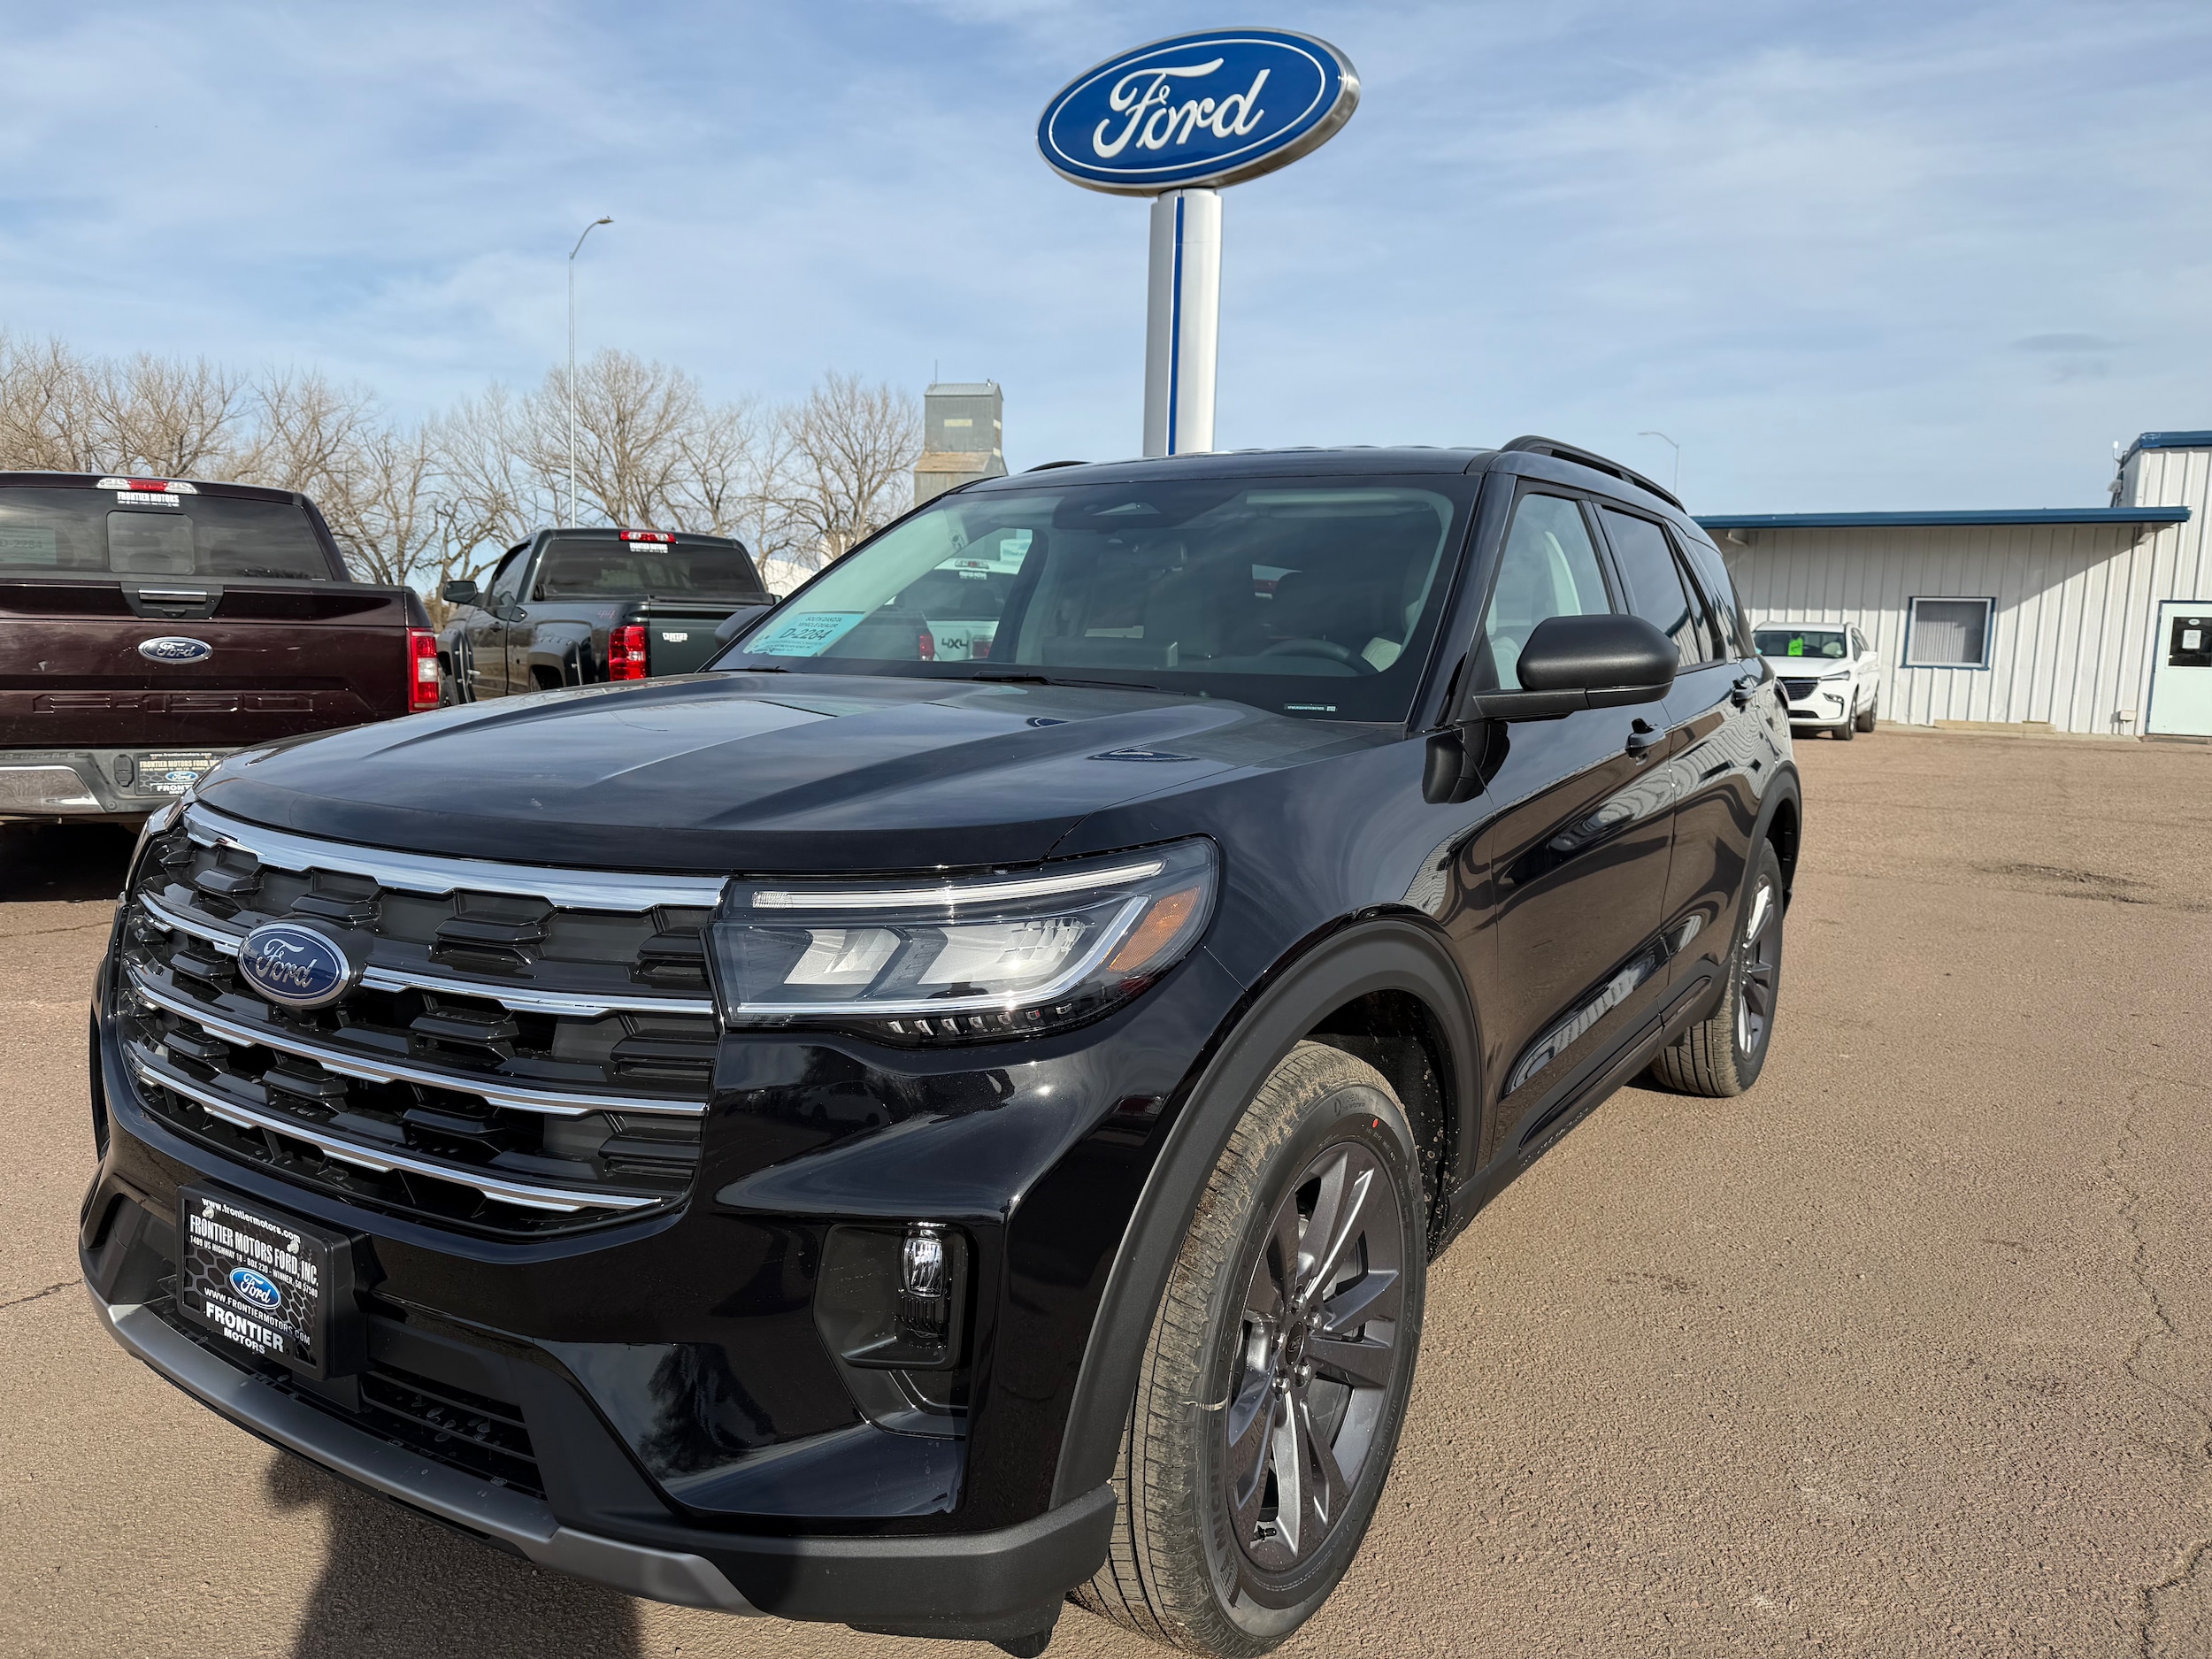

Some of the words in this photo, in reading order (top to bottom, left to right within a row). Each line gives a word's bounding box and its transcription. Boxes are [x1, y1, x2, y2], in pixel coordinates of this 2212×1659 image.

[1093, 58, 1271, 158] Ford
[156, 641, 196, 657] Ford
[779, 627, 833, 640] D-2284
[33, 694, 314, 713] F-150
[255, 938, 318, 979] Ford
[202, 1197, 301, 1243] www.frontiermotors.com
[190, 1214, 234, 1248] FRONTIER
[234, 1231, 273, 1264] MOTORS
[274, 1248, 300, 1279] FORD,
[301, 1260, 319, 1286] INC.
[204, 1240, 211, 1249] US
[247, 1257, 257, 1270] BOX
[240, 1273, 271, 1304] Ford
[204, 1286, 311, 1346] WWW.FRONTIERMOTORS.COM
[205, 1301, 284, 1353] FRONTIER
[223, 1327, 265, 1355] MOTORS
